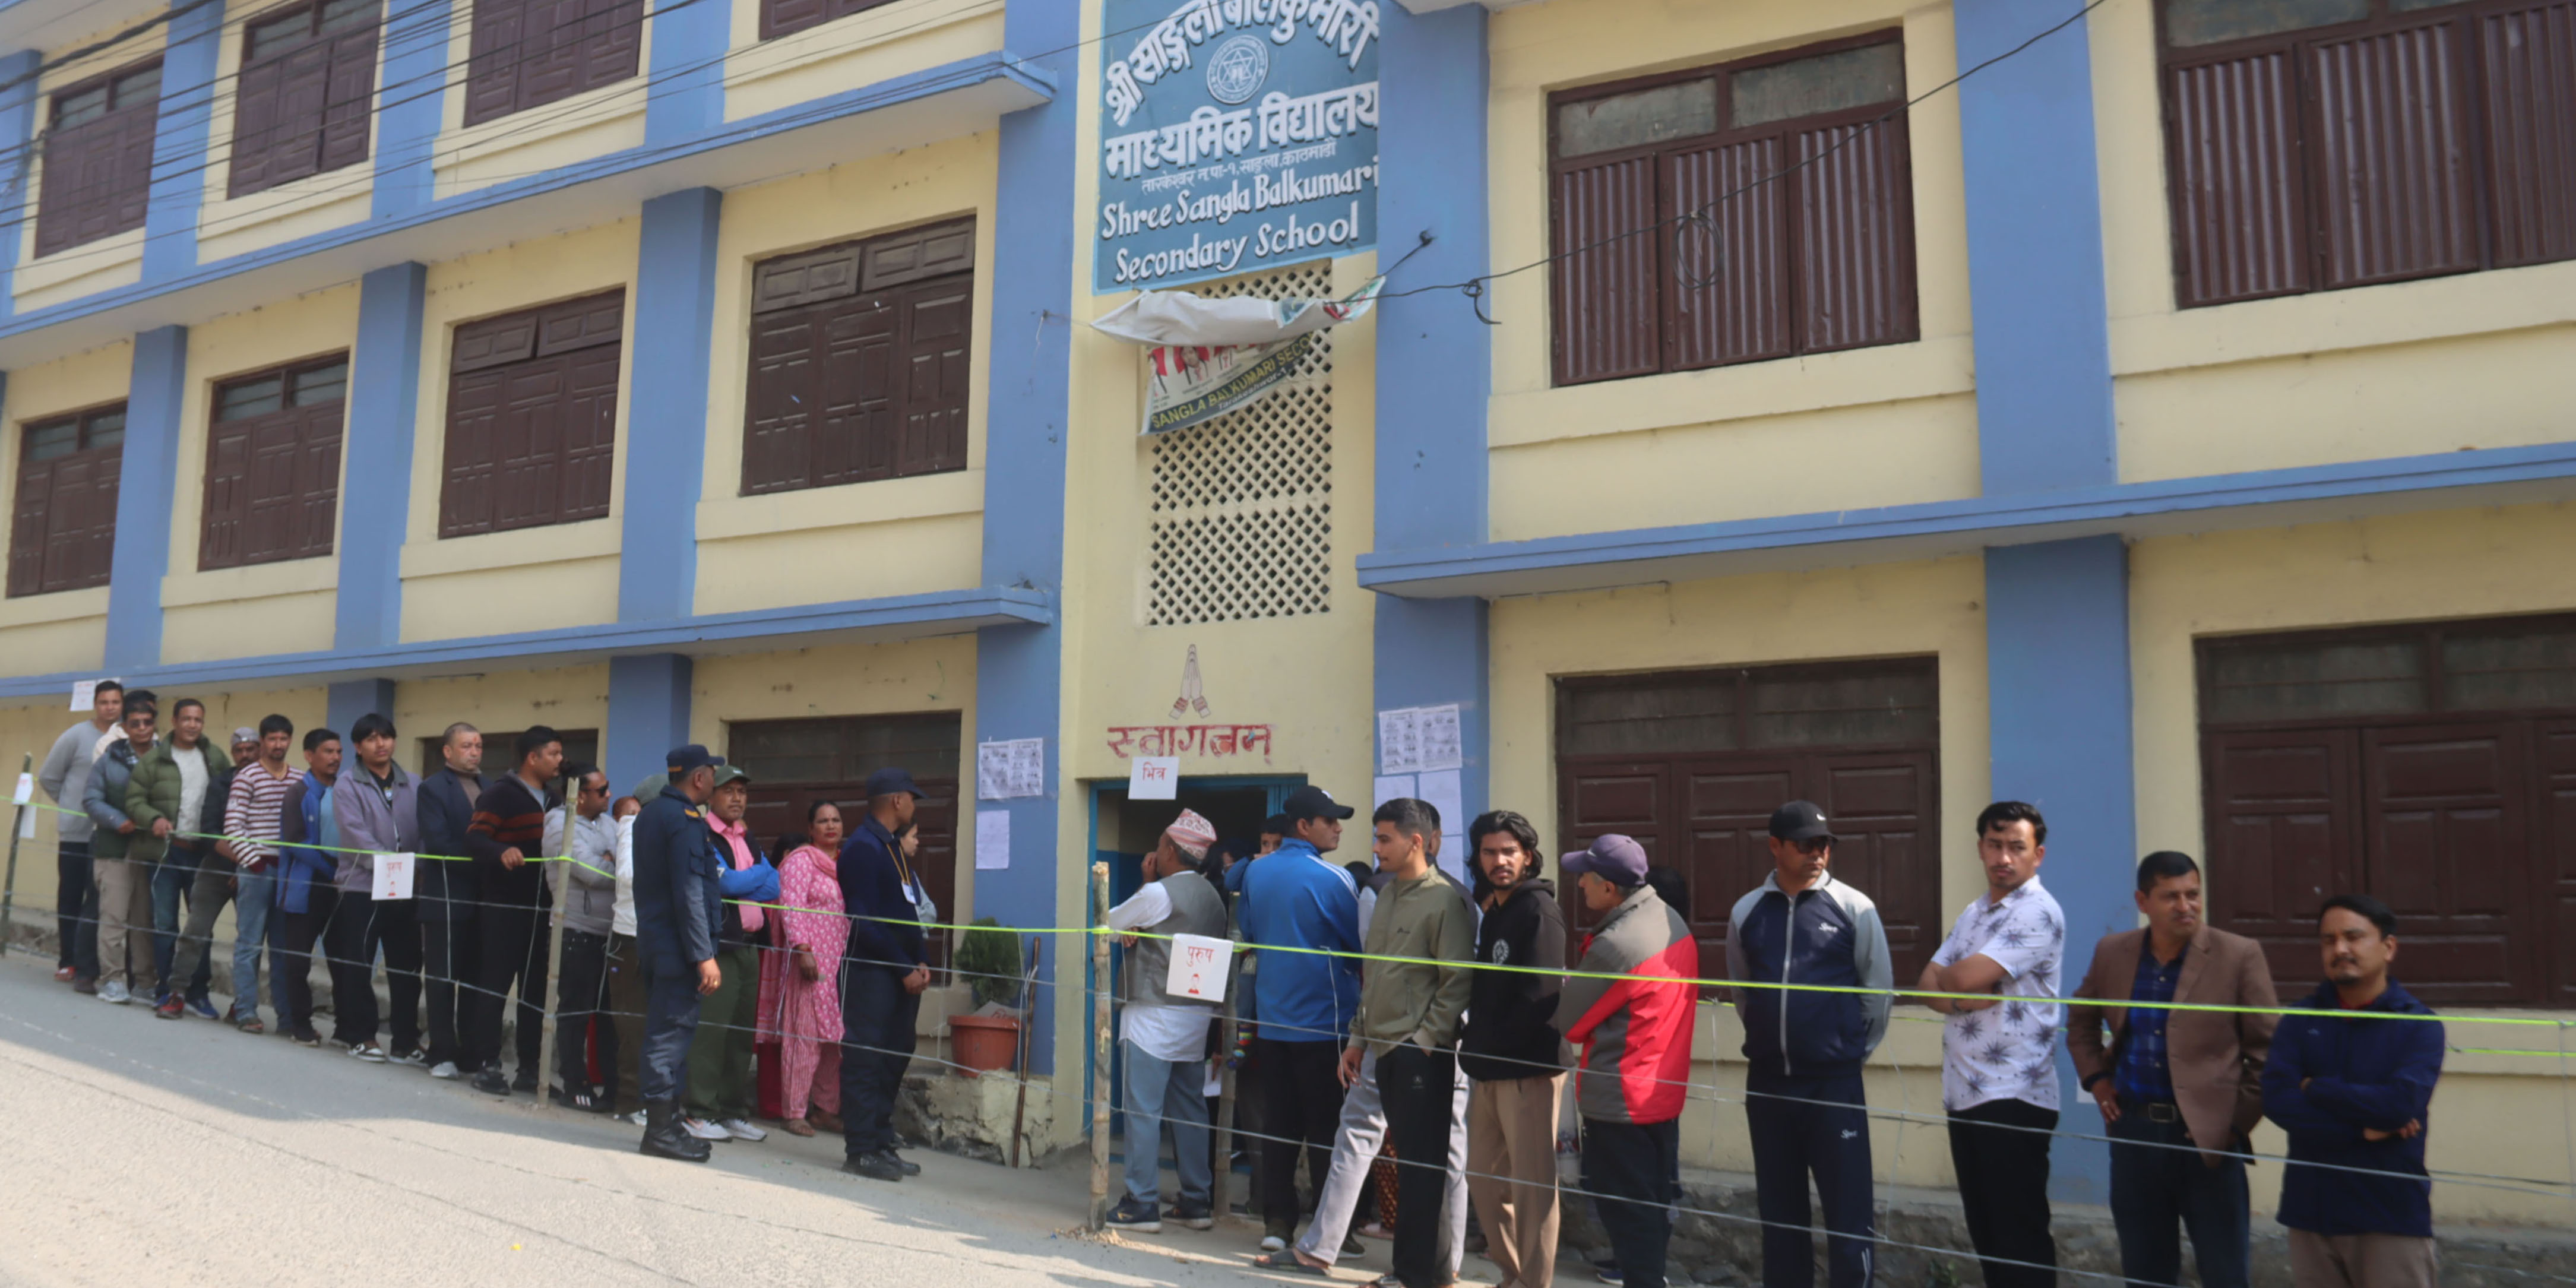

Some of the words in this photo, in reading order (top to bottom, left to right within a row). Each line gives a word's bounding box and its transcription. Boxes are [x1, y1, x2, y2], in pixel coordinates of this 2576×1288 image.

[1105, 106, 1253, 178] माध्यमिक
[1258, 81, 1378, 150] विद्यालय
[1106, 61, 1143, 126] श्री
[1102, 201, 1172, 239] Shree
[1176, 179, 1251, 224] Sangla
[1254, 156, 1378, 211] Balkumari
[1115, 234, 1247, 283] Secondary
[1255, 201, 1359, 257] School
[1151, 400, 1207, 429] SANGLA
[1208, 360, 1276, 407] BALKUMARI
[1142, 761, 1167, 781] भित्र
